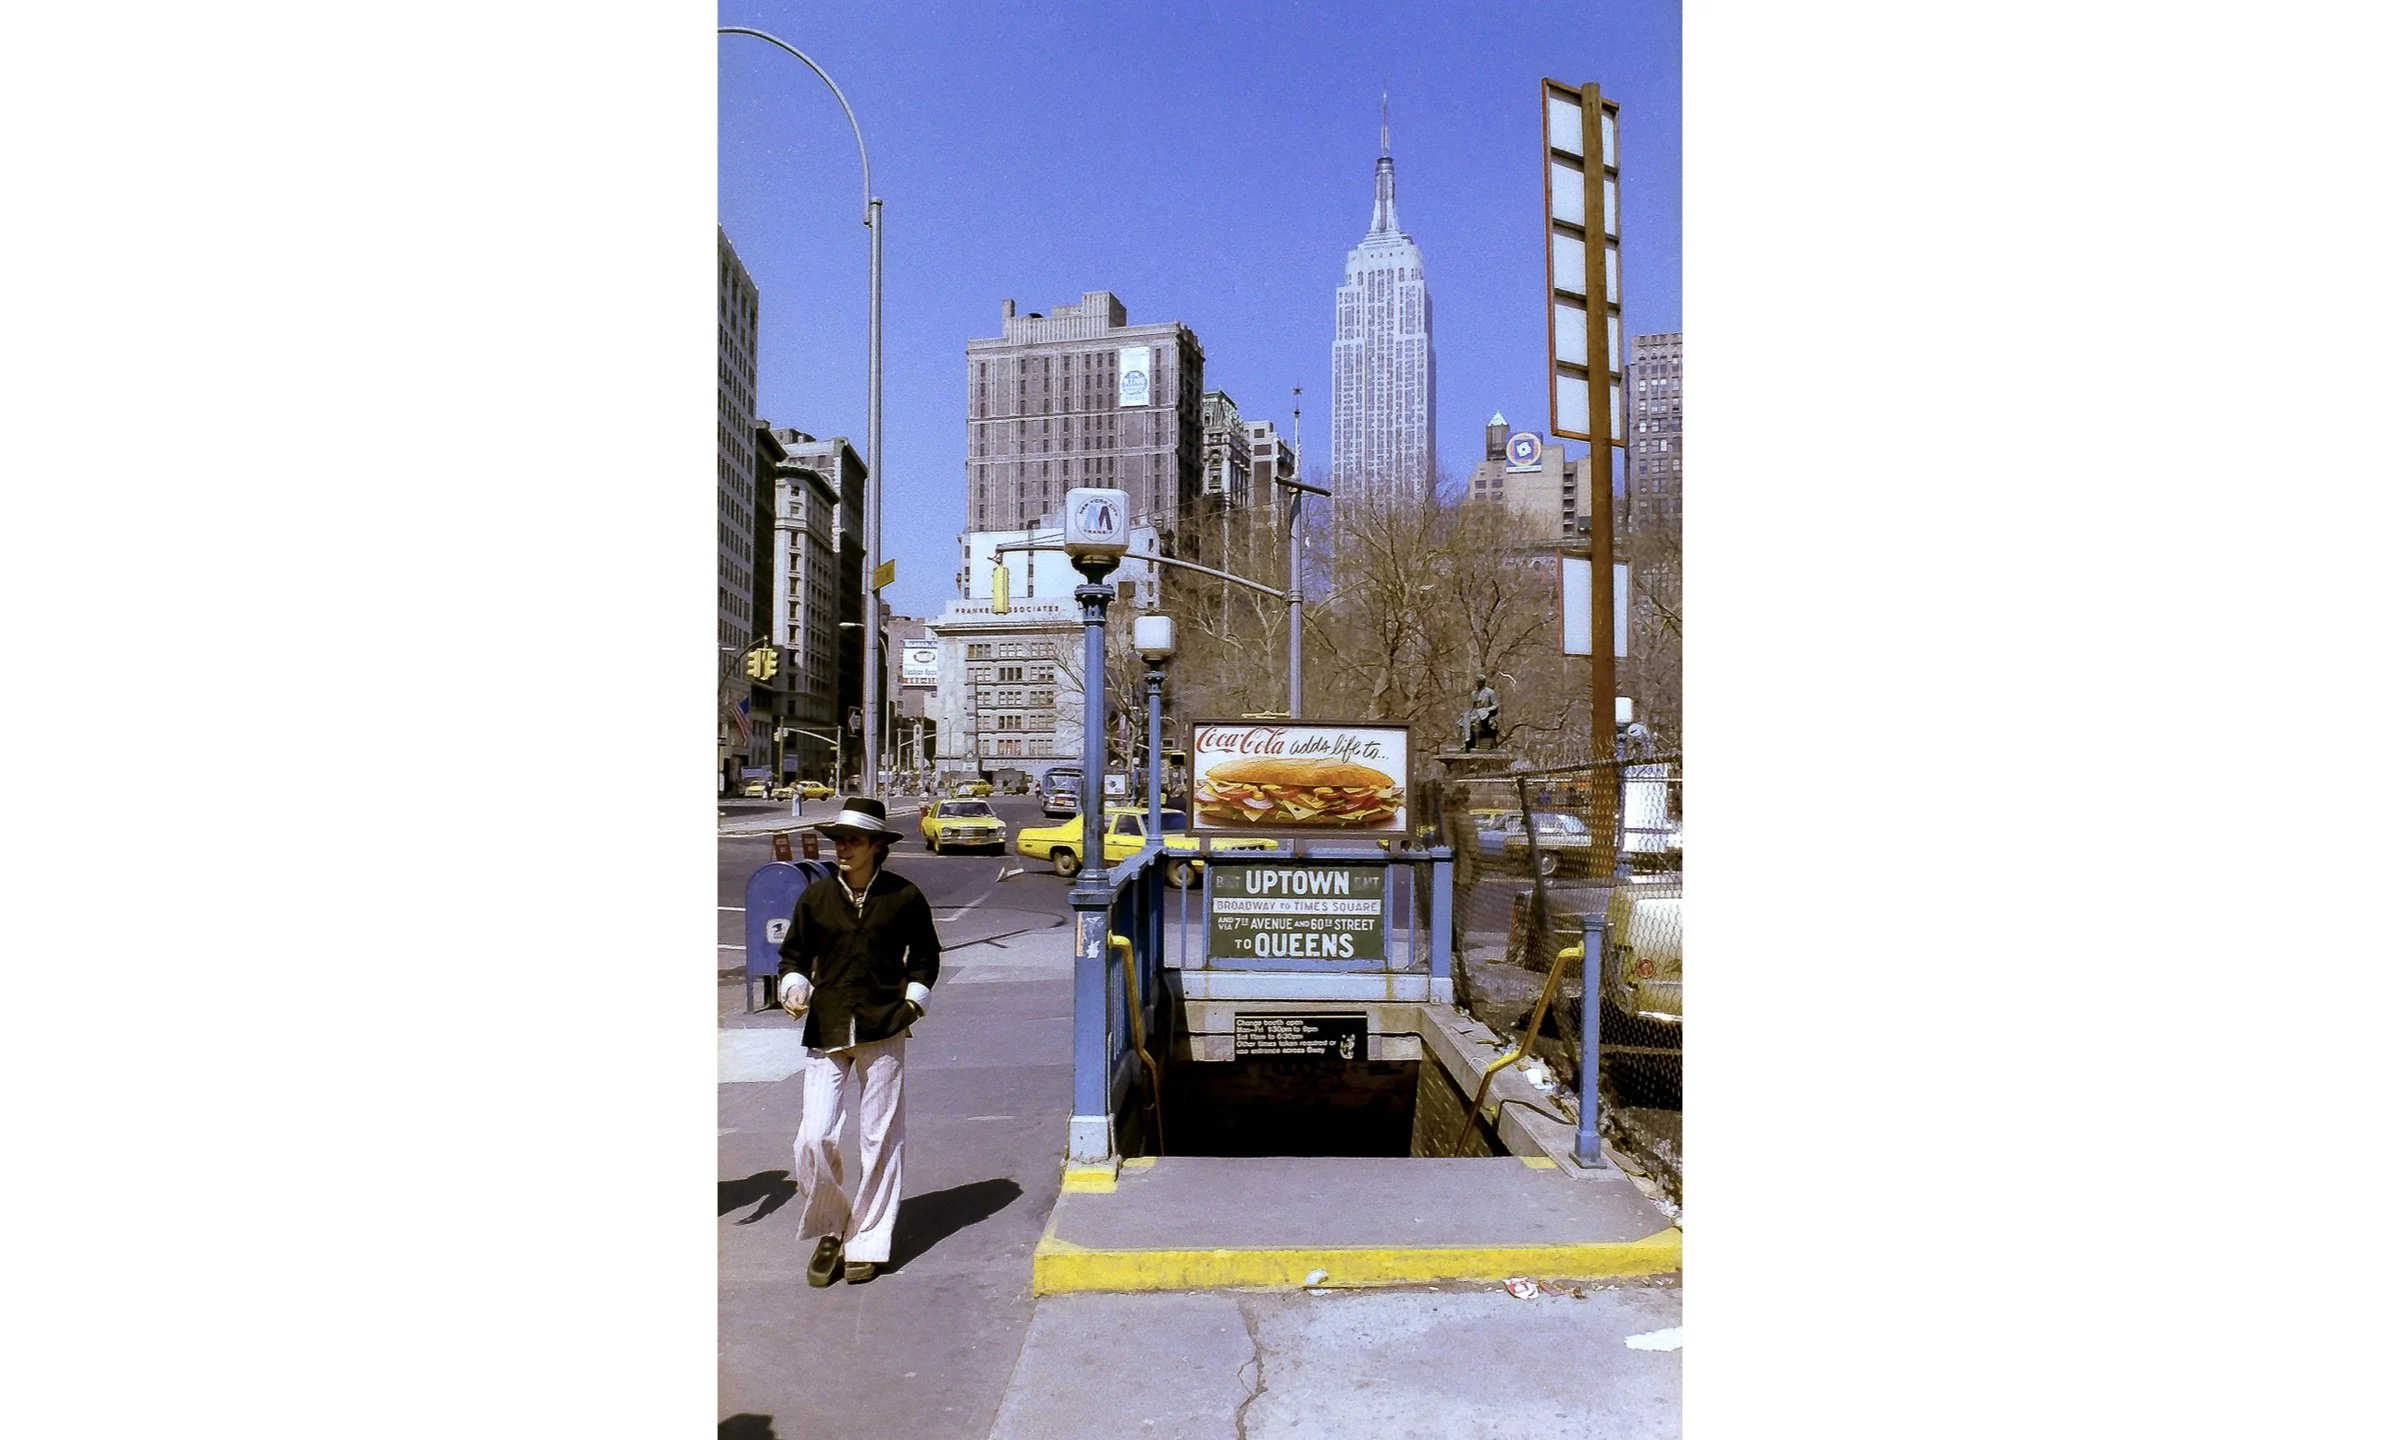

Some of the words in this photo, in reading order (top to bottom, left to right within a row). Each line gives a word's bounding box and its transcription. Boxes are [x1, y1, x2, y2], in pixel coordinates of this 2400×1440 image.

[1197, 726, 1288, 754] Coca-Cola
[1290, 735, 1330, 755] adds
[1331, 734, 1360, 763] life
[1246, 870, 1349, 895] UPTOWN
[1217, 901, 1275, 910] BROADWAY
[1294, 901, 1328, 911] TIMES
[1333, 902, 1377, 912] SQUARE
[1250, 918, 1293, 930] AVENUE
[1294, 920, 1310, 928] AND
[1334, 919, 1375, 931] STREET
[1235, 938, 1252, 949] TO
[1255, 932, 1354, 958] QUEENS
